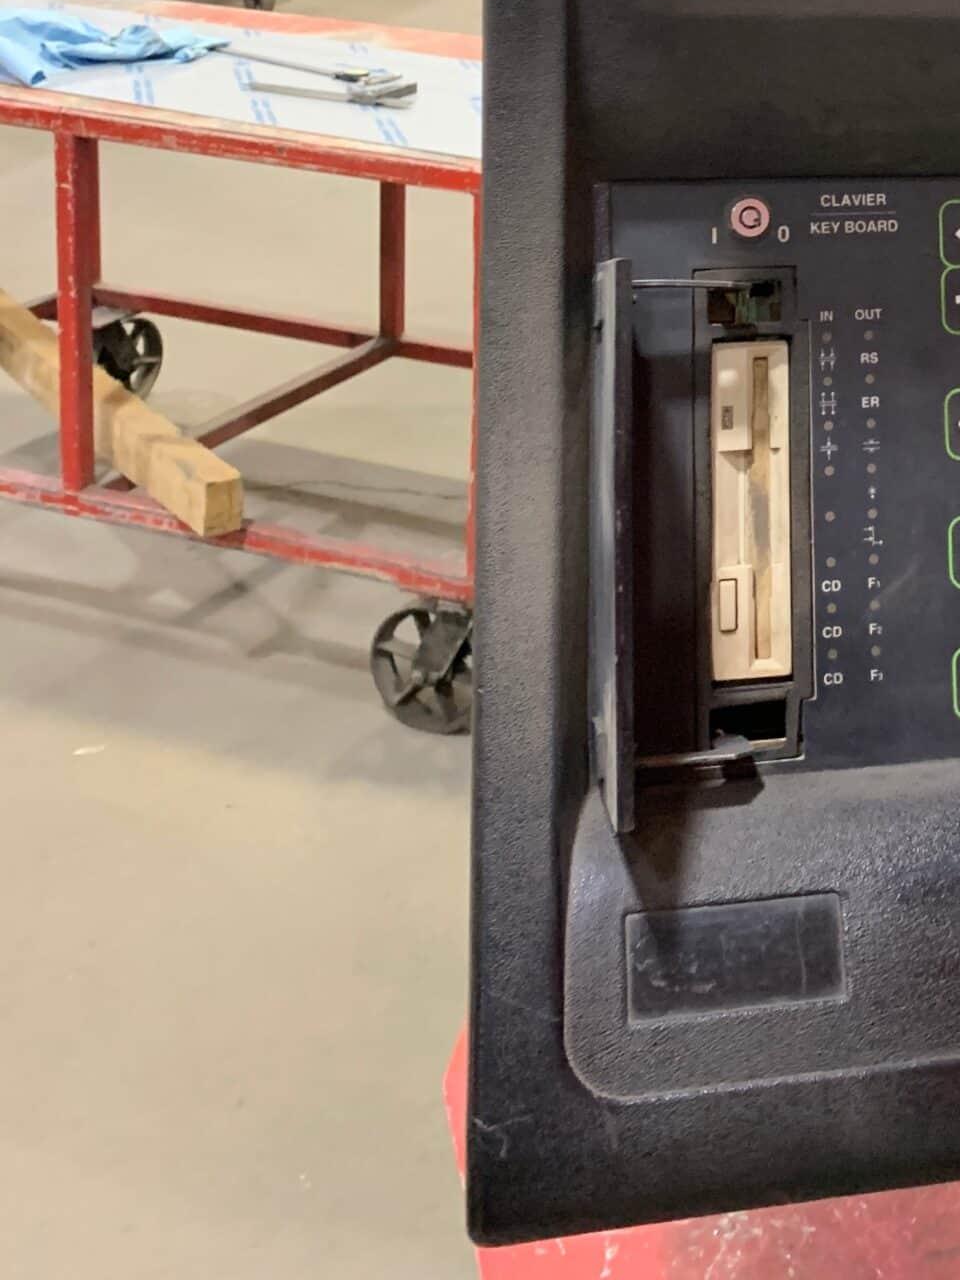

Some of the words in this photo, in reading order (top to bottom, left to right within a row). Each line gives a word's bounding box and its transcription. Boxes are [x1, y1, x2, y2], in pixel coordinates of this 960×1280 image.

[820, 193, 887, 208] CLAVIER
[809, 221, 841, 235] KEY
[843, 219, 899, 234] BOARD
[819, 310, 834, 322] IN
[854, 308, 883, 321] OUT
[860, 351, 880, 365] RS
[861, 395, 881, 409] ER
[821, 579, 842, 593] CD
[821, 625, 843, 639] CD
[823, 671, 844, 686] CD
